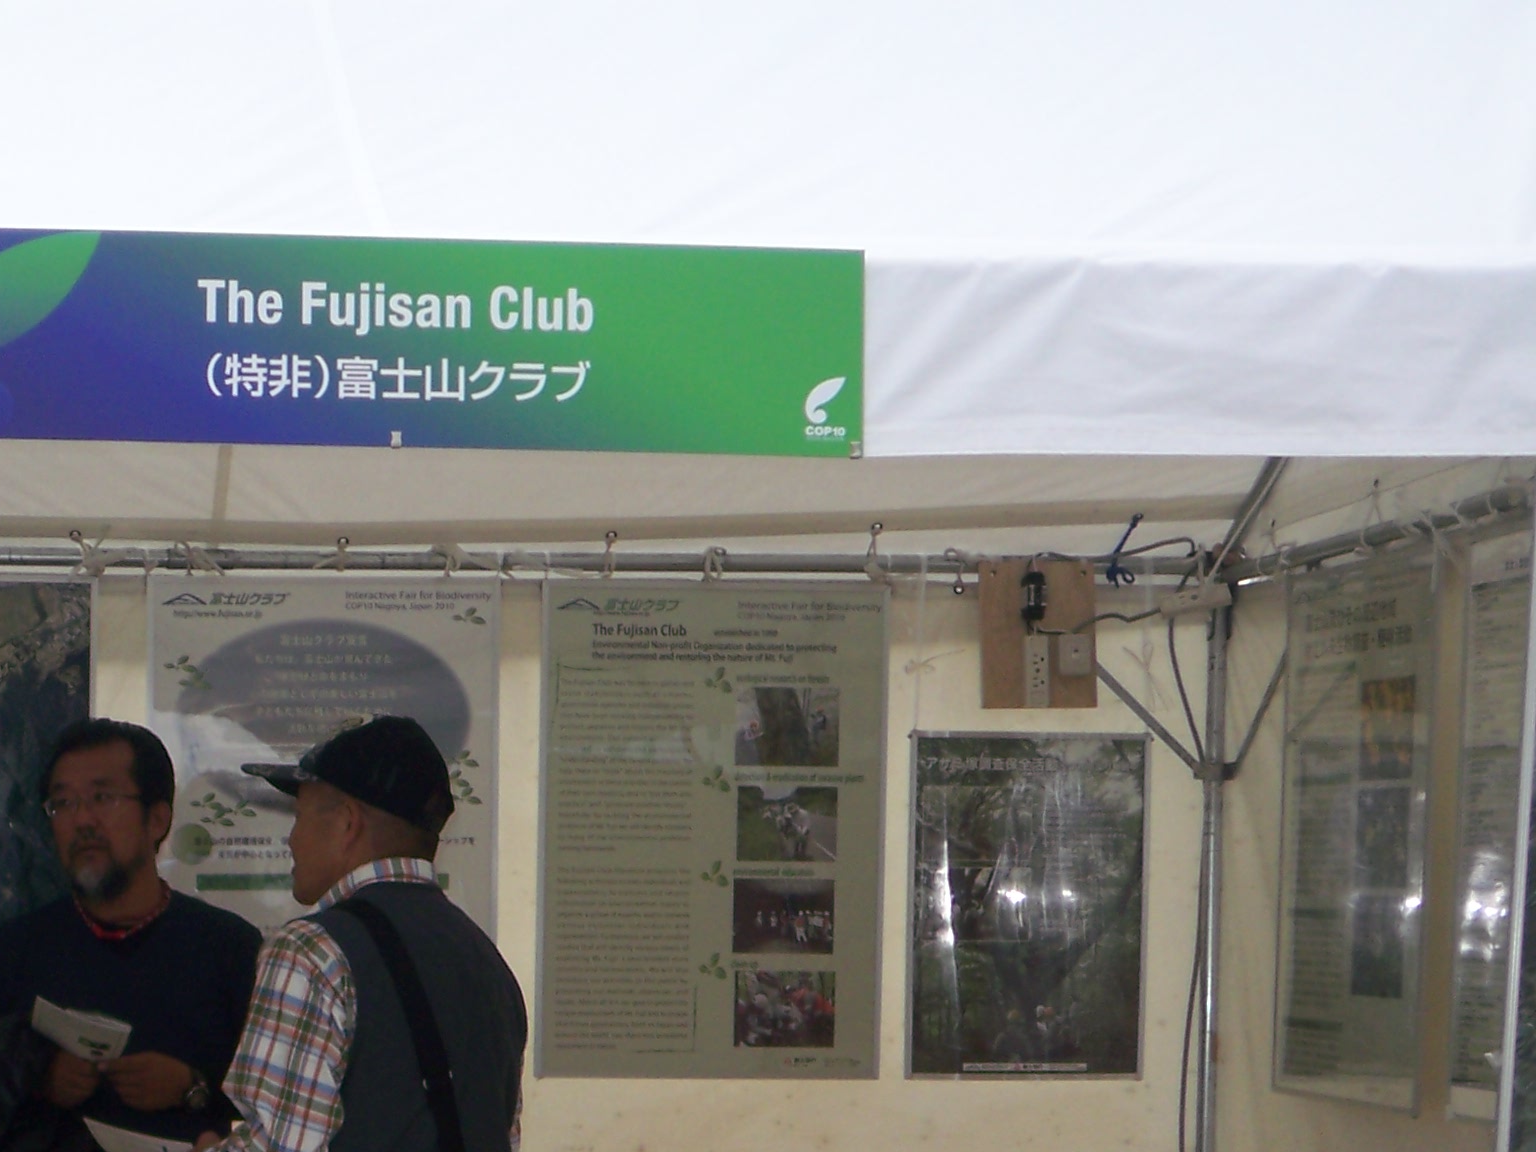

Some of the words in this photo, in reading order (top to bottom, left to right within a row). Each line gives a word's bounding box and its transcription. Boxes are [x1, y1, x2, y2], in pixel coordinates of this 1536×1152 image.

[197, 279, 283, 324] The
[301, 281, 471, 336] Fujisan
[490, 285, 594, 332] Club
[206, 353, 591, 401] (特非)富士山クラブ
[805, 425, 846, 436] COP10
[209, 592, 291, 605] 富士山クラブ
[345, 590, 397, 600] Interactive
[400, 590, 417, 600] Fair
[419, 590, 432, 600] for
[435, 590, 492, 602] Biodiversity
[435, 602, 455, 610] 2010
[592, 623, 614, 636] The
[616, 623, 658, 638] Fujisan
[660, 624, 687, 637] Club
[659, 652, 674, 661] and
[713, 652, 726, 661] the
